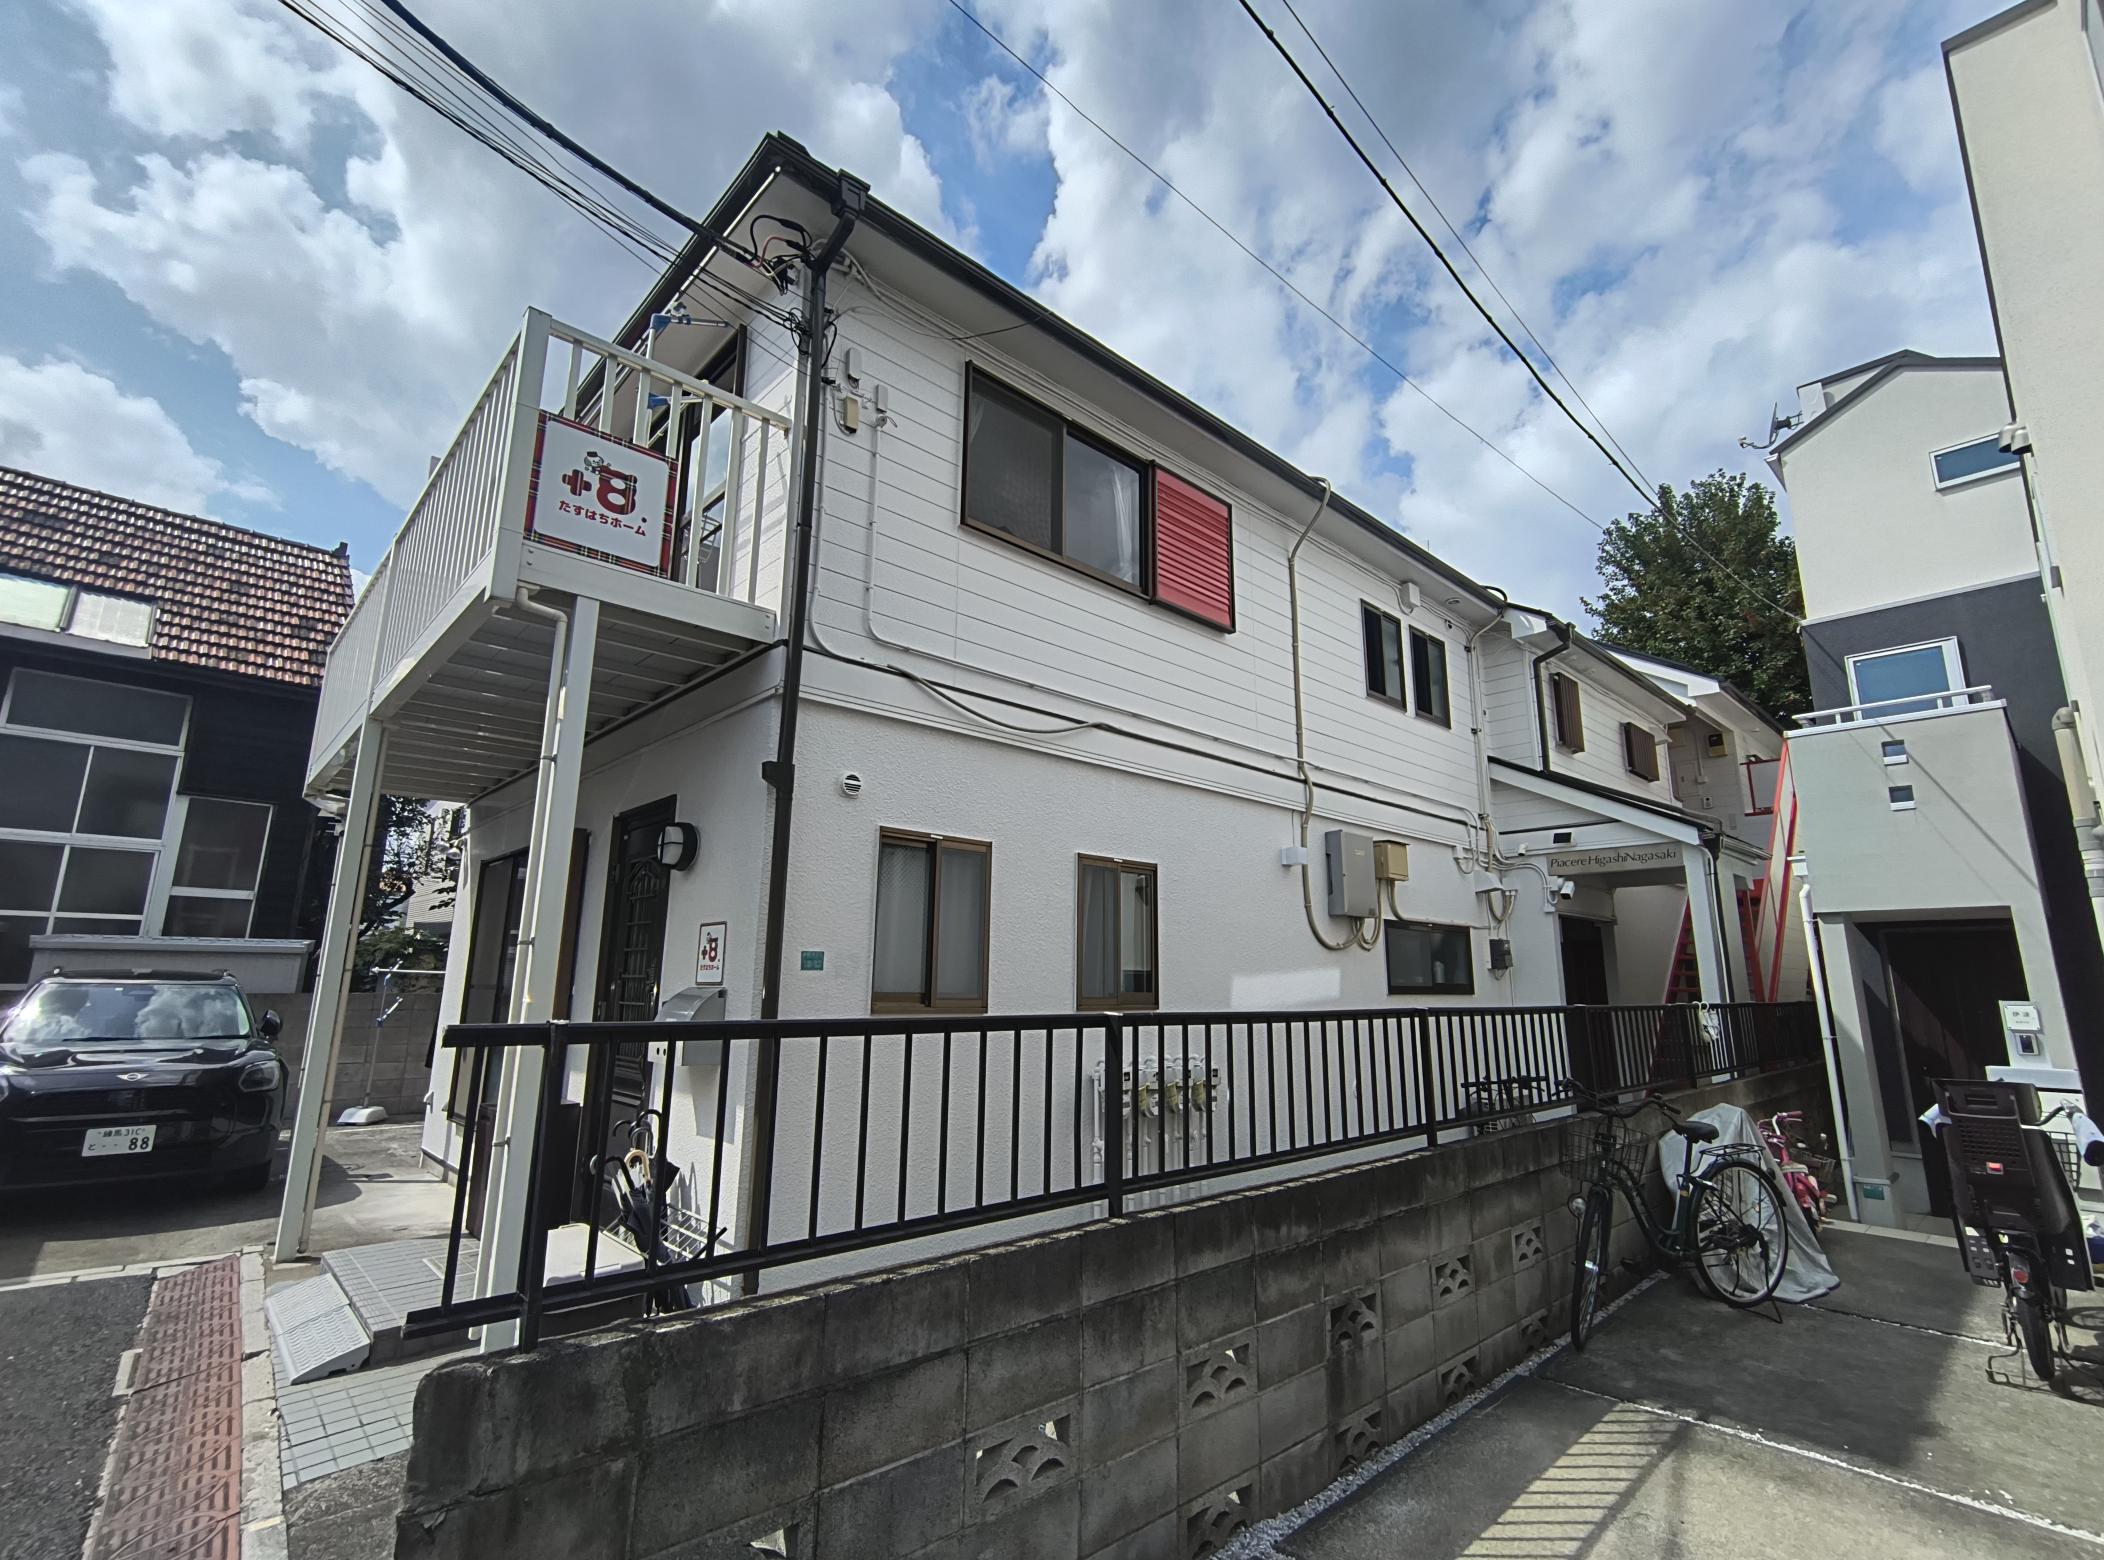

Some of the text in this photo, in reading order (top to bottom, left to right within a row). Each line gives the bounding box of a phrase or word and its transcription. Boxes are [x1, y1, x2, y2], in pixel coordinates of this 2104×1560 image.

[558, 500, 646, 537] たすはちホーム
[1551, 857, 1587, 868] Piacere
